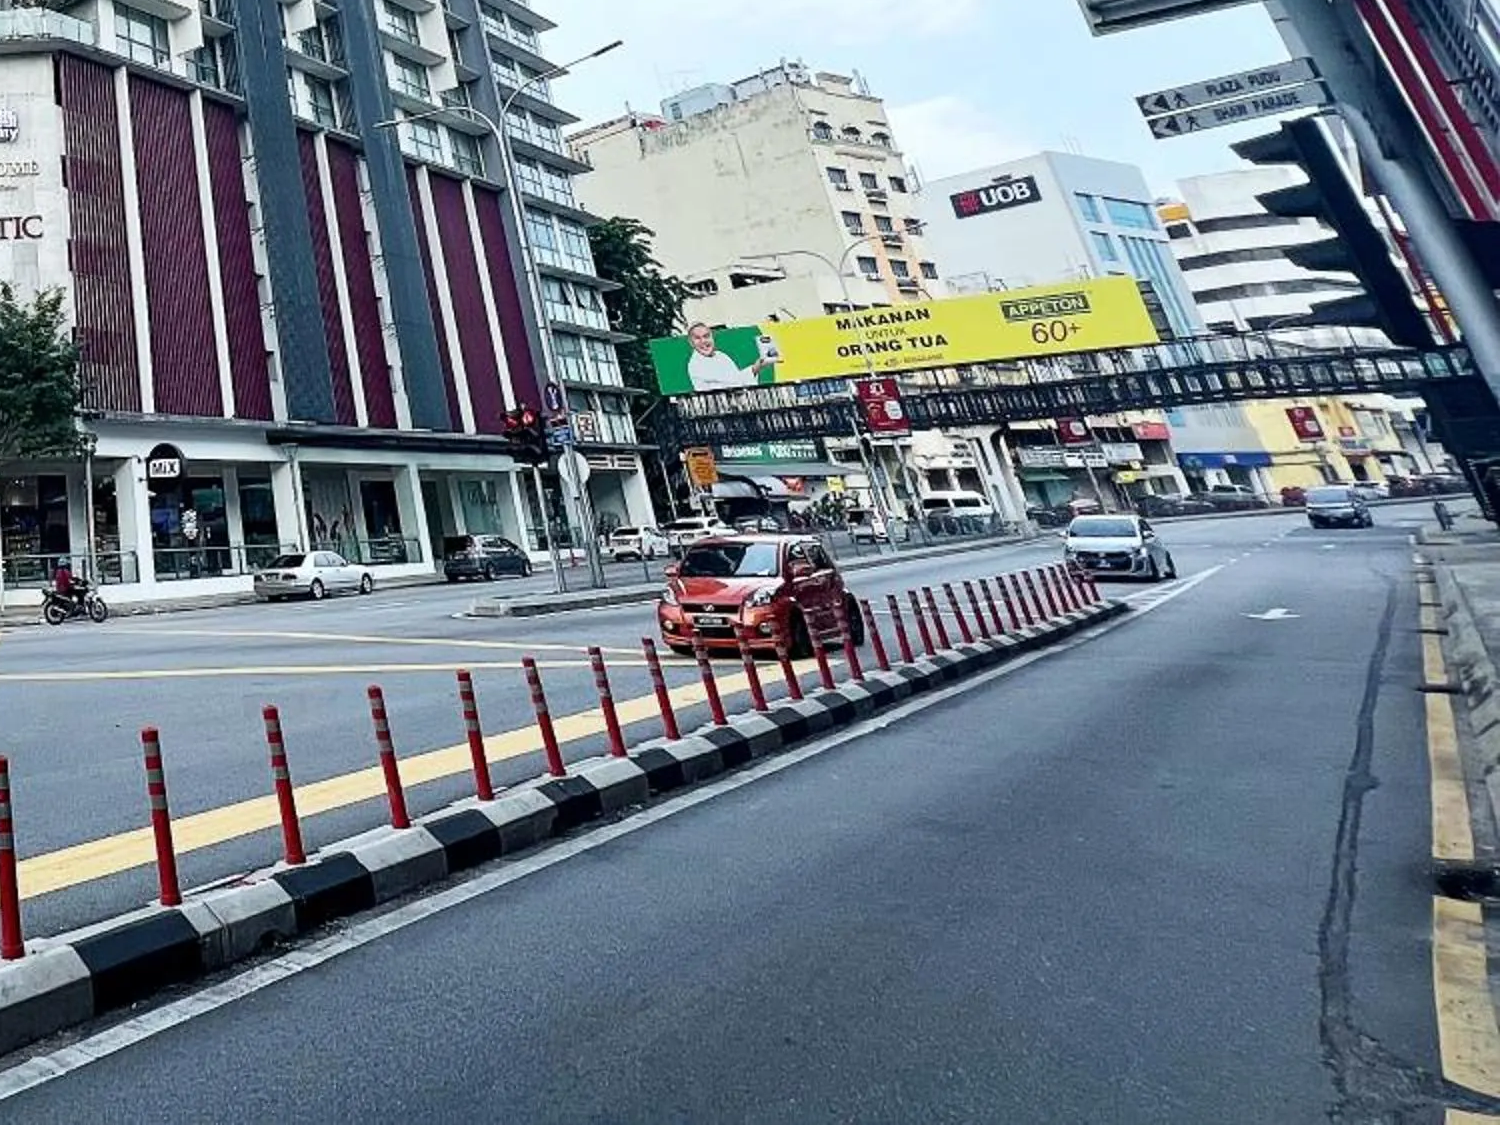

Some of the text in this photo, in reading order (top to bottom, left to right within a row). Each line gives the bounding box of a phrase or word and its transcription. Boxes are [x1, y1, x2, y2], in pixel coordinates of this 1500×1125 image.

[979, 182, 1031, 207] UOB
[1008, 297, 1085, 317] APPETON
[836, 308, 930, 330] MAKANAN
[865, 327, 906, 340] UNTUK
[1032, 320, 1081, 344] 60+
[837, 334, 948, 357] ORANG TUA
